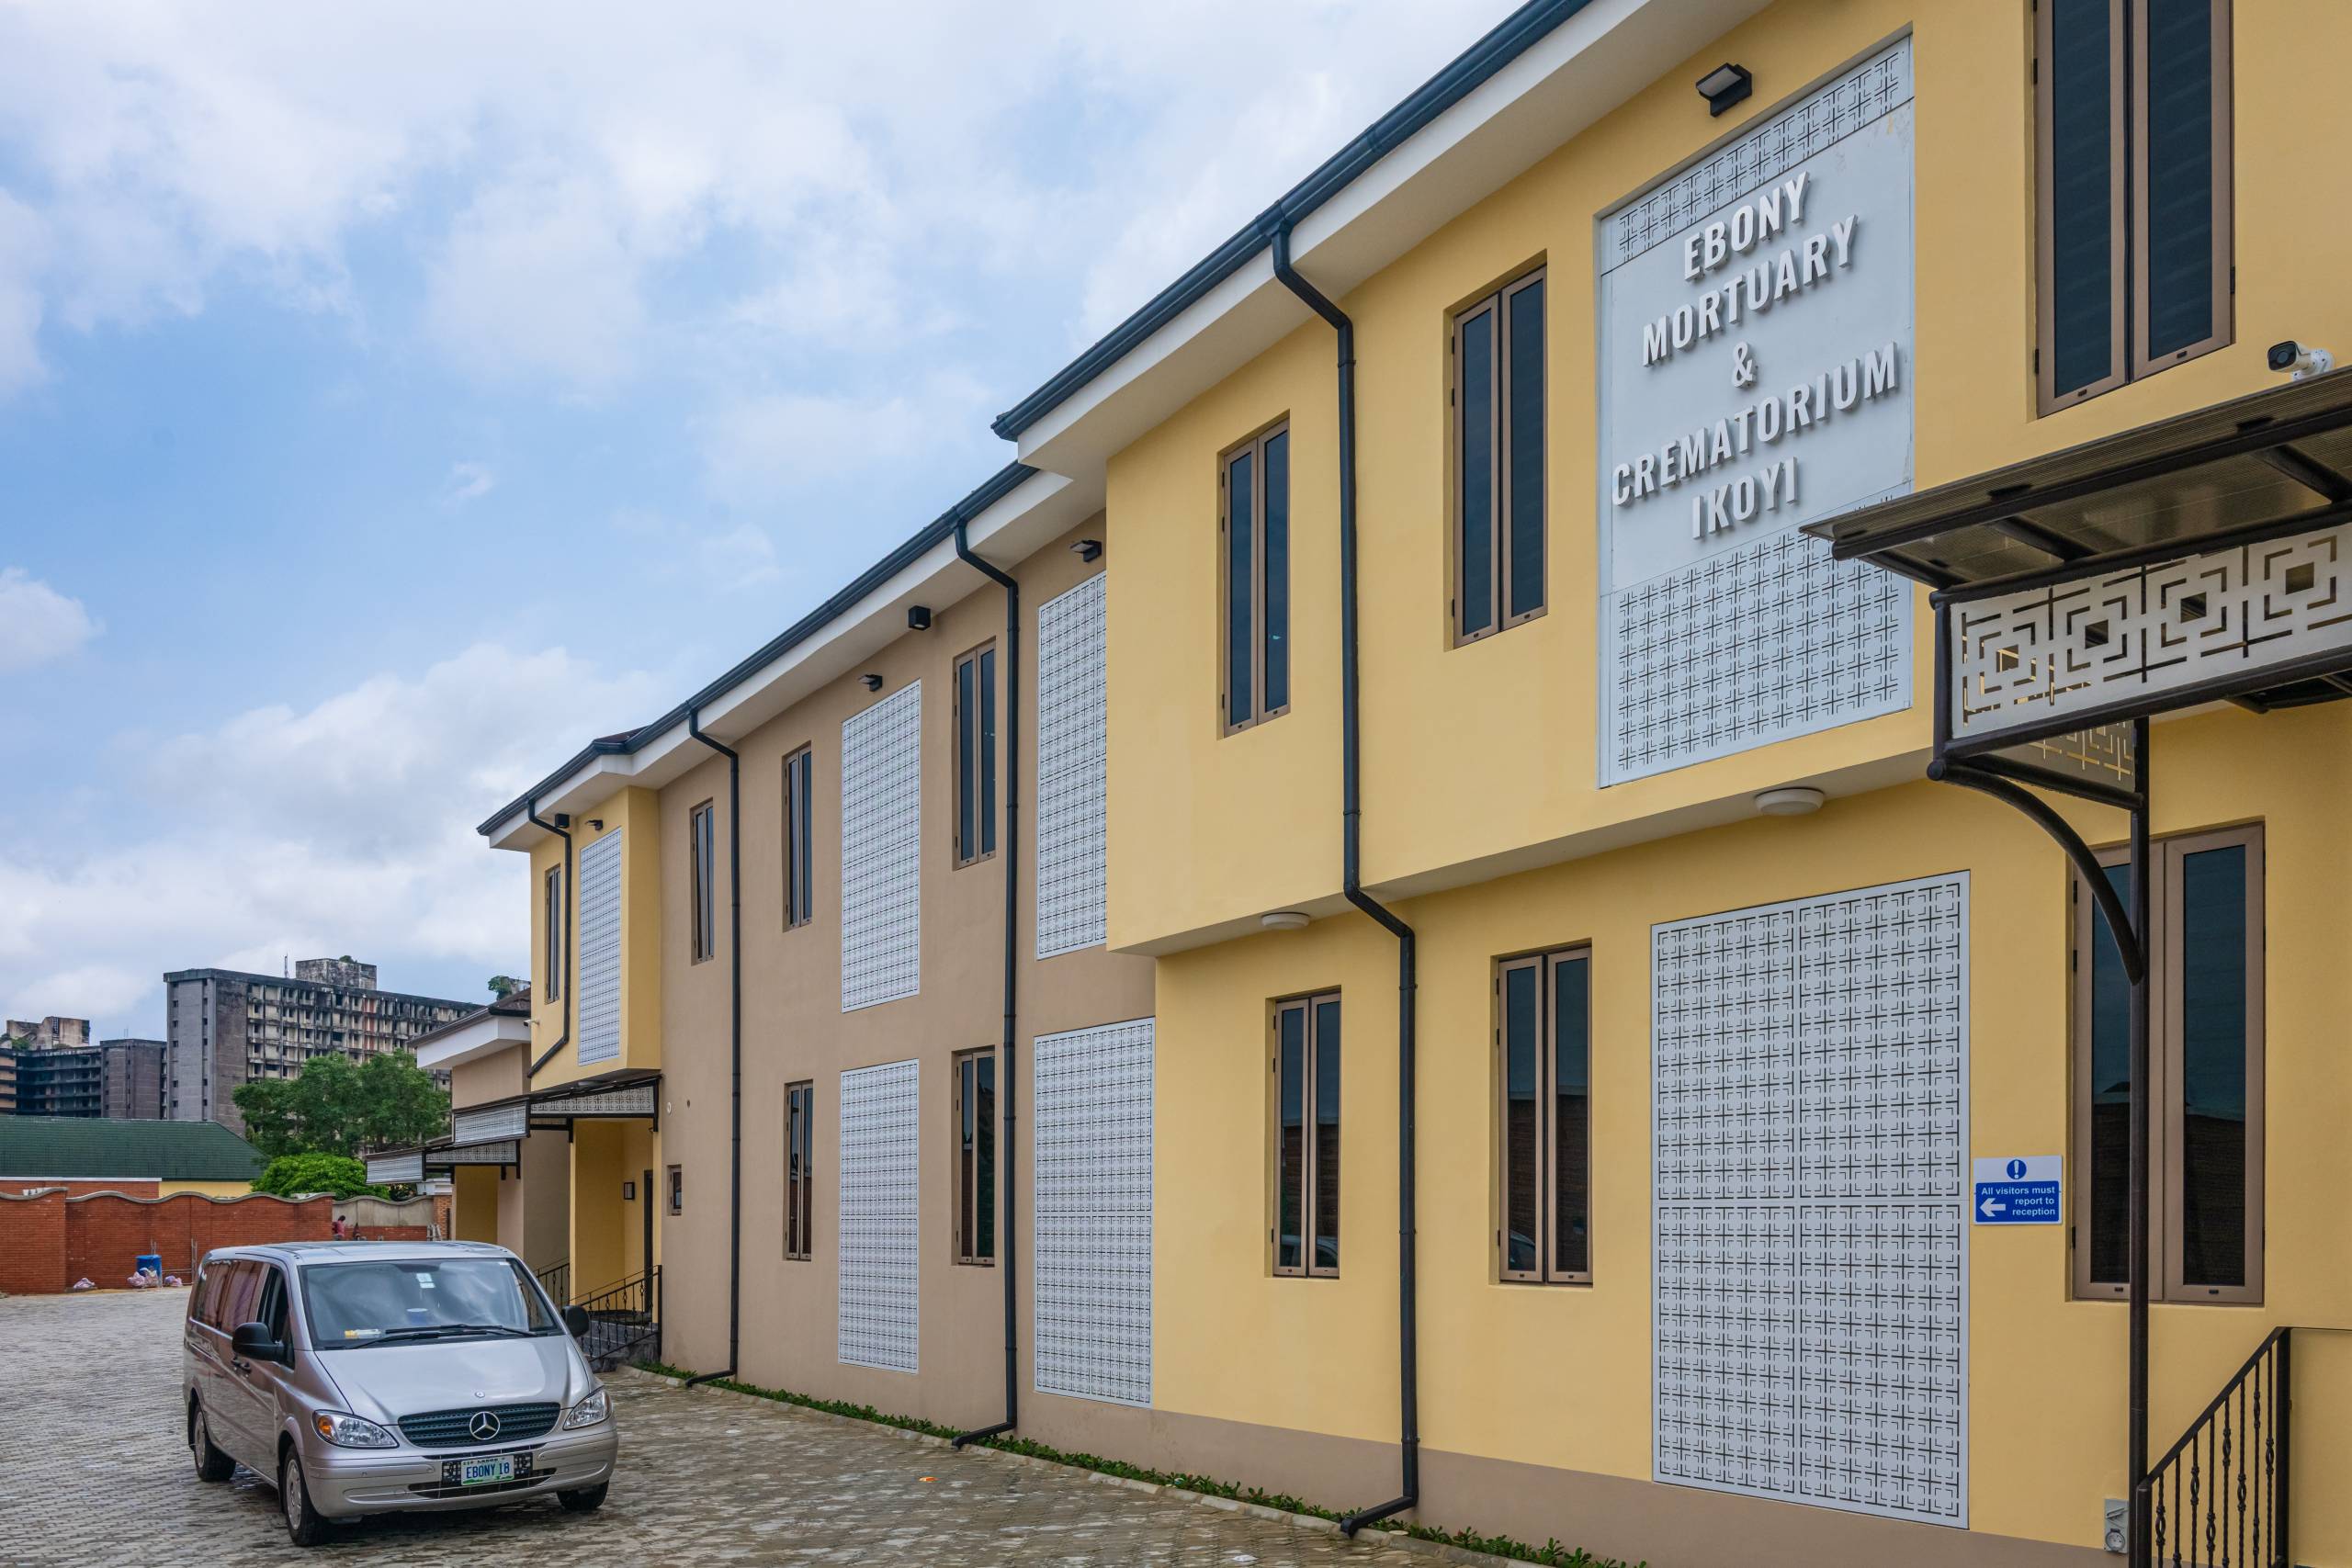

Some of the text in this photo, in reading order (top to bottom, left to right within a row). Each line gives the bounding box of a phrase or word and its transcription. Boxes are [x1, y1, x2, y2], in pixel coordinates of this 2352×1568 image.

[1684, 171, 1810, 281] EBONY
[1643, 214, 1859, 367] MORTUARY
[1732, 341, 1755, 388] &
[1611, 341, 1897, 506] CREMATORIUM
[1692, 457, 1797, 539] IKOYI
[1981, 1186, 2055, 1195] All visitors must
[2012, 1208, 2055, 1217] reception
[2015, 1197, 2042, 1206] report
[466, 1463, 495, 1478] EBONY
